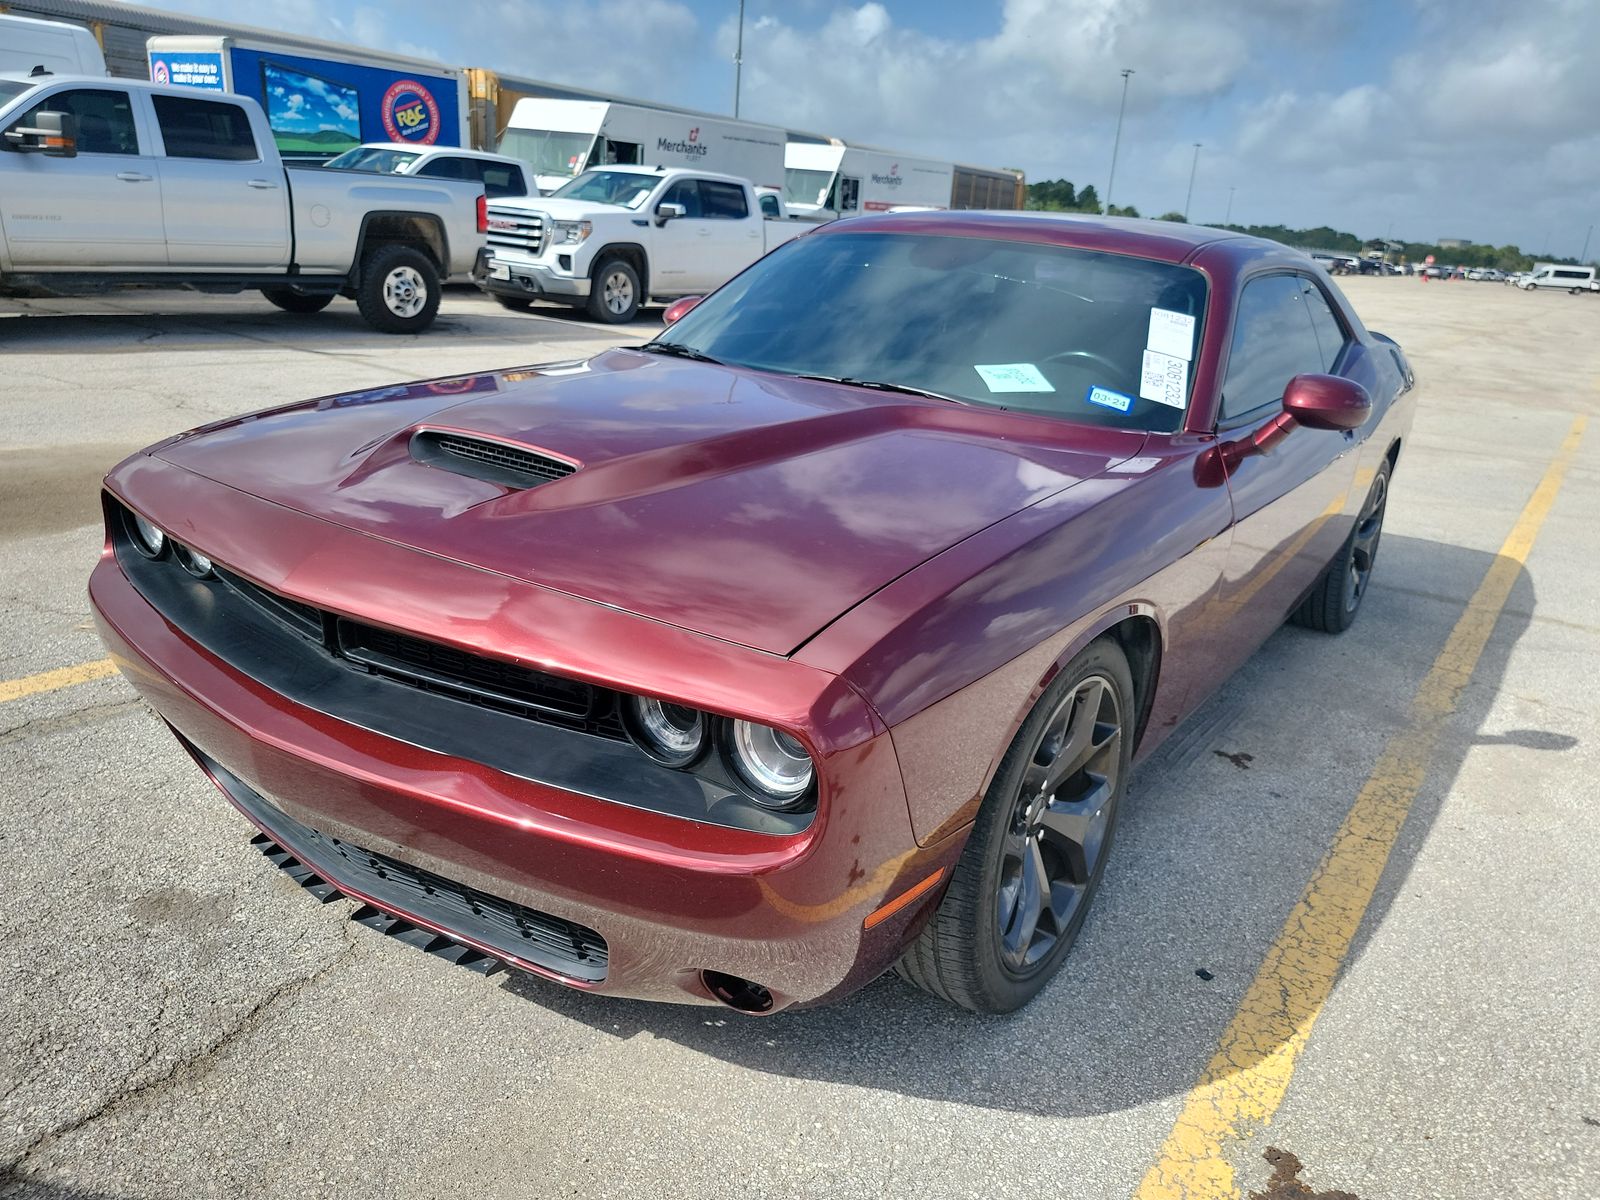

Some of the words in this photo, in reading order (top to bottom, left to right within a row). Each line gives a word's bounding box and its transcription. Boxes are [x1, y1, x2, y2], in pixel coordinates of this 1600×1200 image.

[657, 137, 707, 155] Merchants
[871, 174, 903, 186] Merchants
[1164, 360, 1183, 406] 3081232
